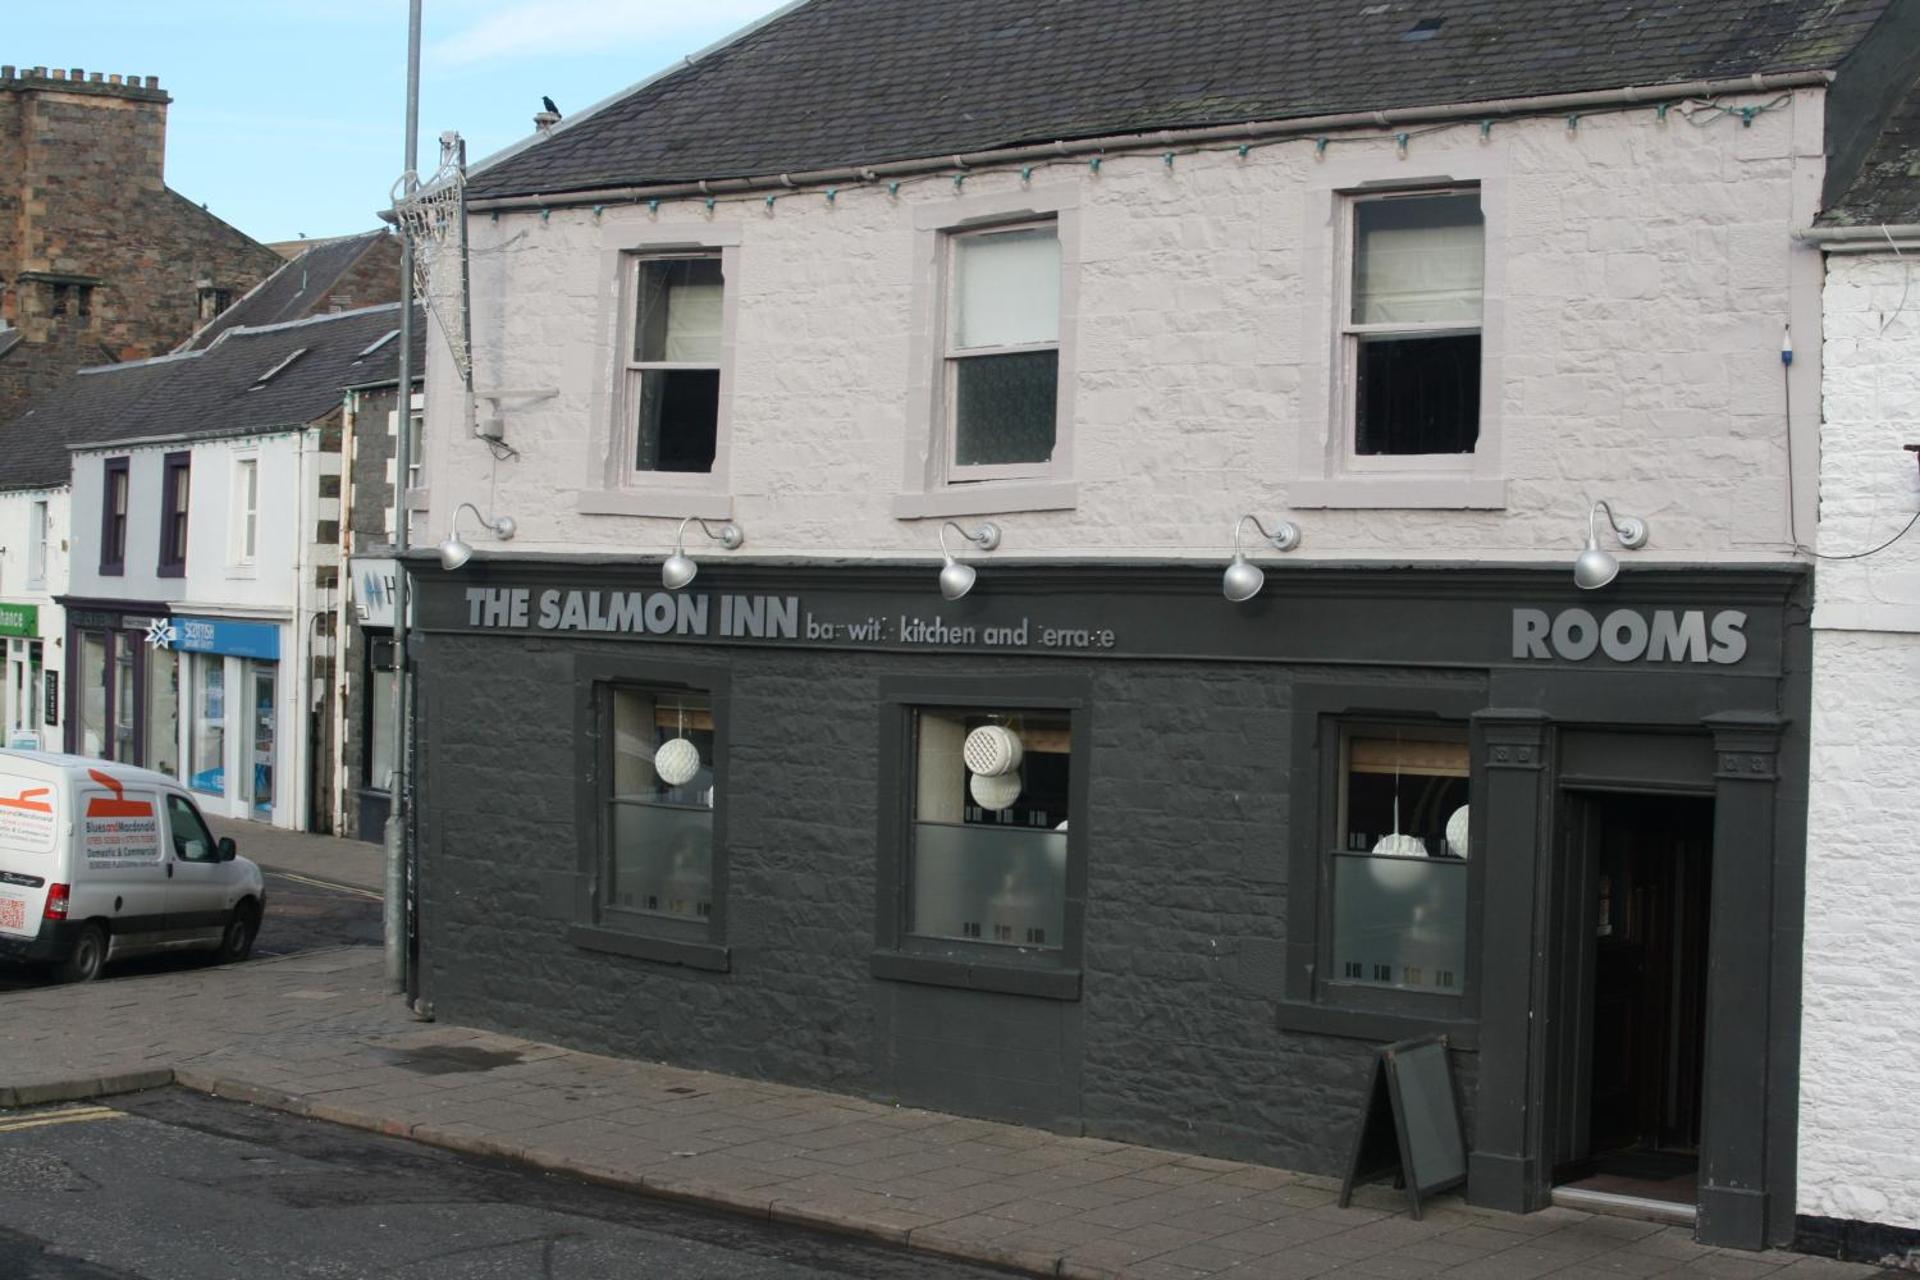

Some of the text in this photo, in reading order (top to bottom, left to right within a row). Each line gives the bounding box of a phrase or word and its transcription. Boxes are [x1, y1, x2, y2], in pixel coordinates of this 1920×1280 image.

[466, 587, 799, 638] THE SALMON INN
[848, 616, 894, 642] wit
[900, 615, 976, 644] kitchen
[983, 617, 1028, 646] and
[1037, 624, 1115, 649] errae
[1512, 608, 1748, 665] ROOMS
